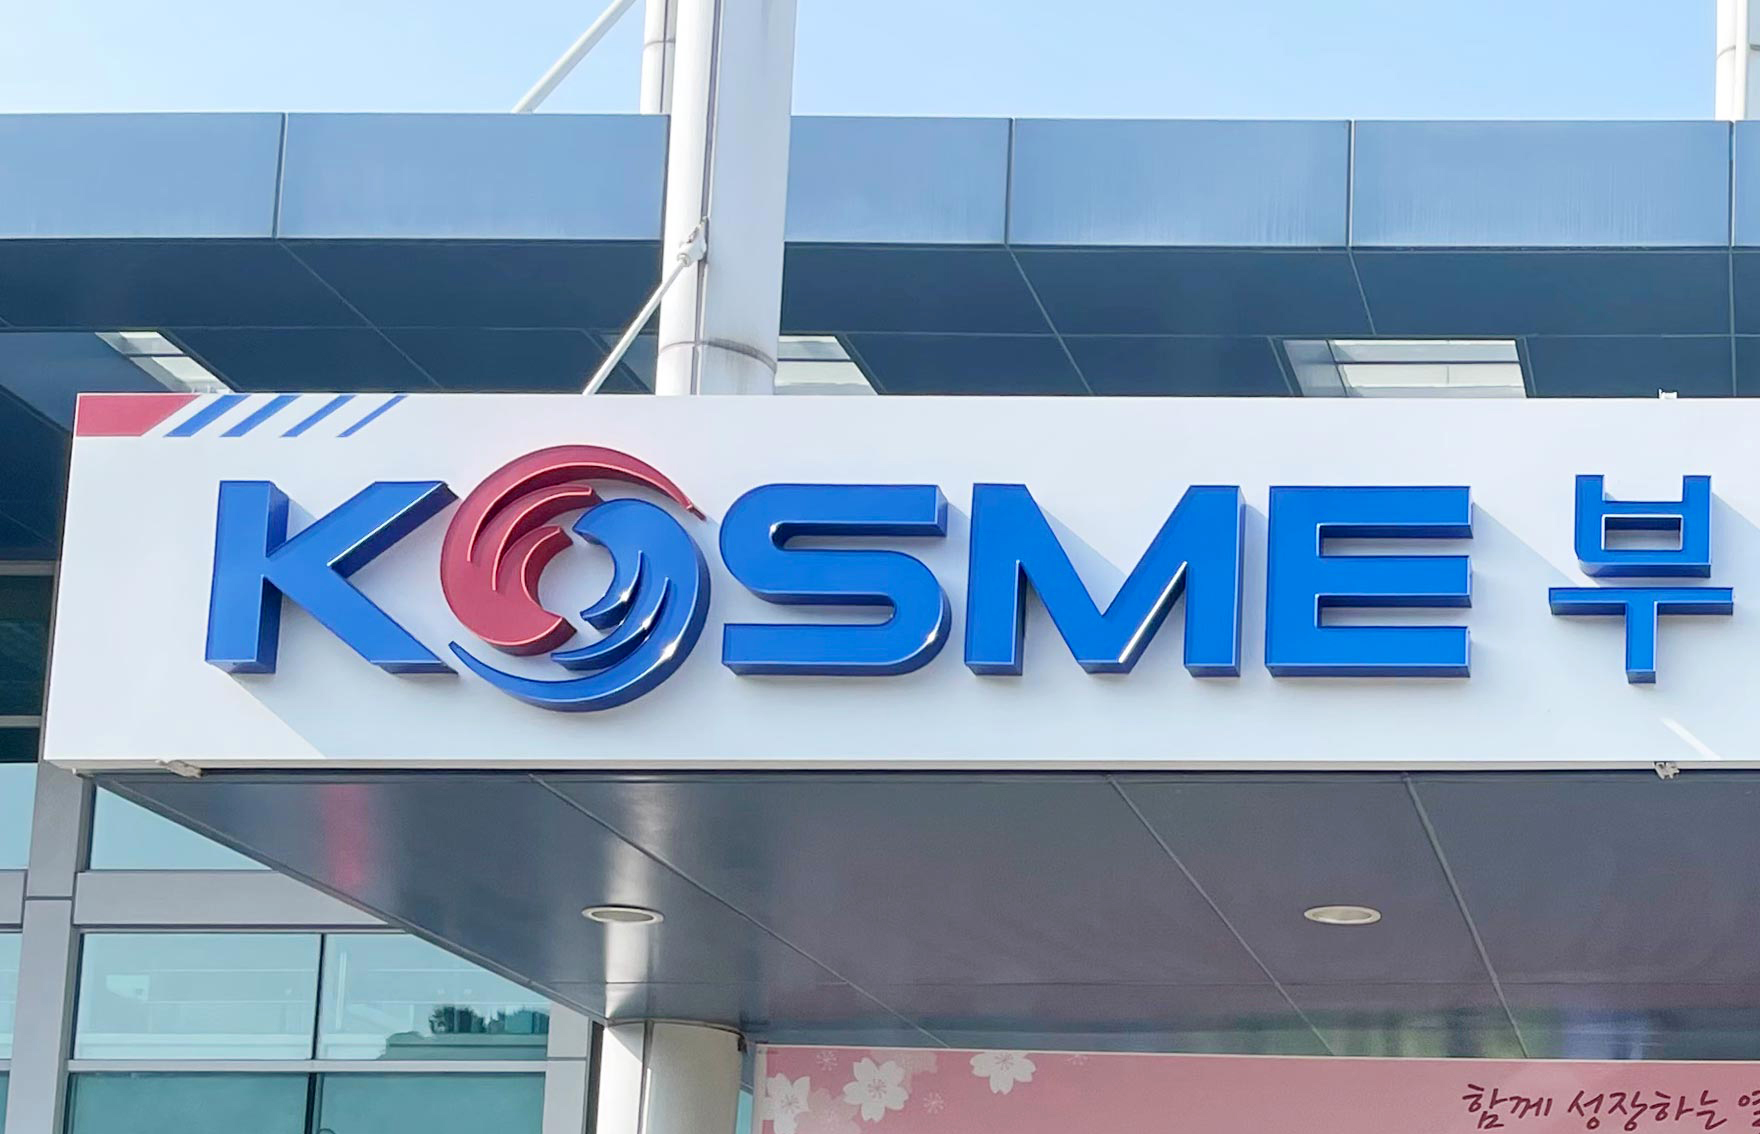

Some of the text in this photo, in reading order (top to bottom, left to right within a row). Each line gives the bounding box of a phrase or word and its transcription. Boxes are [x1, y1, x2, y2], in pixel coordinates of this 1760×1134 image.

[205, 444, 1473, 712] KOSME
[1462, 1083, 1552, 1129] 함께
[1568, 1089, 1728, 1132] 성장하는
